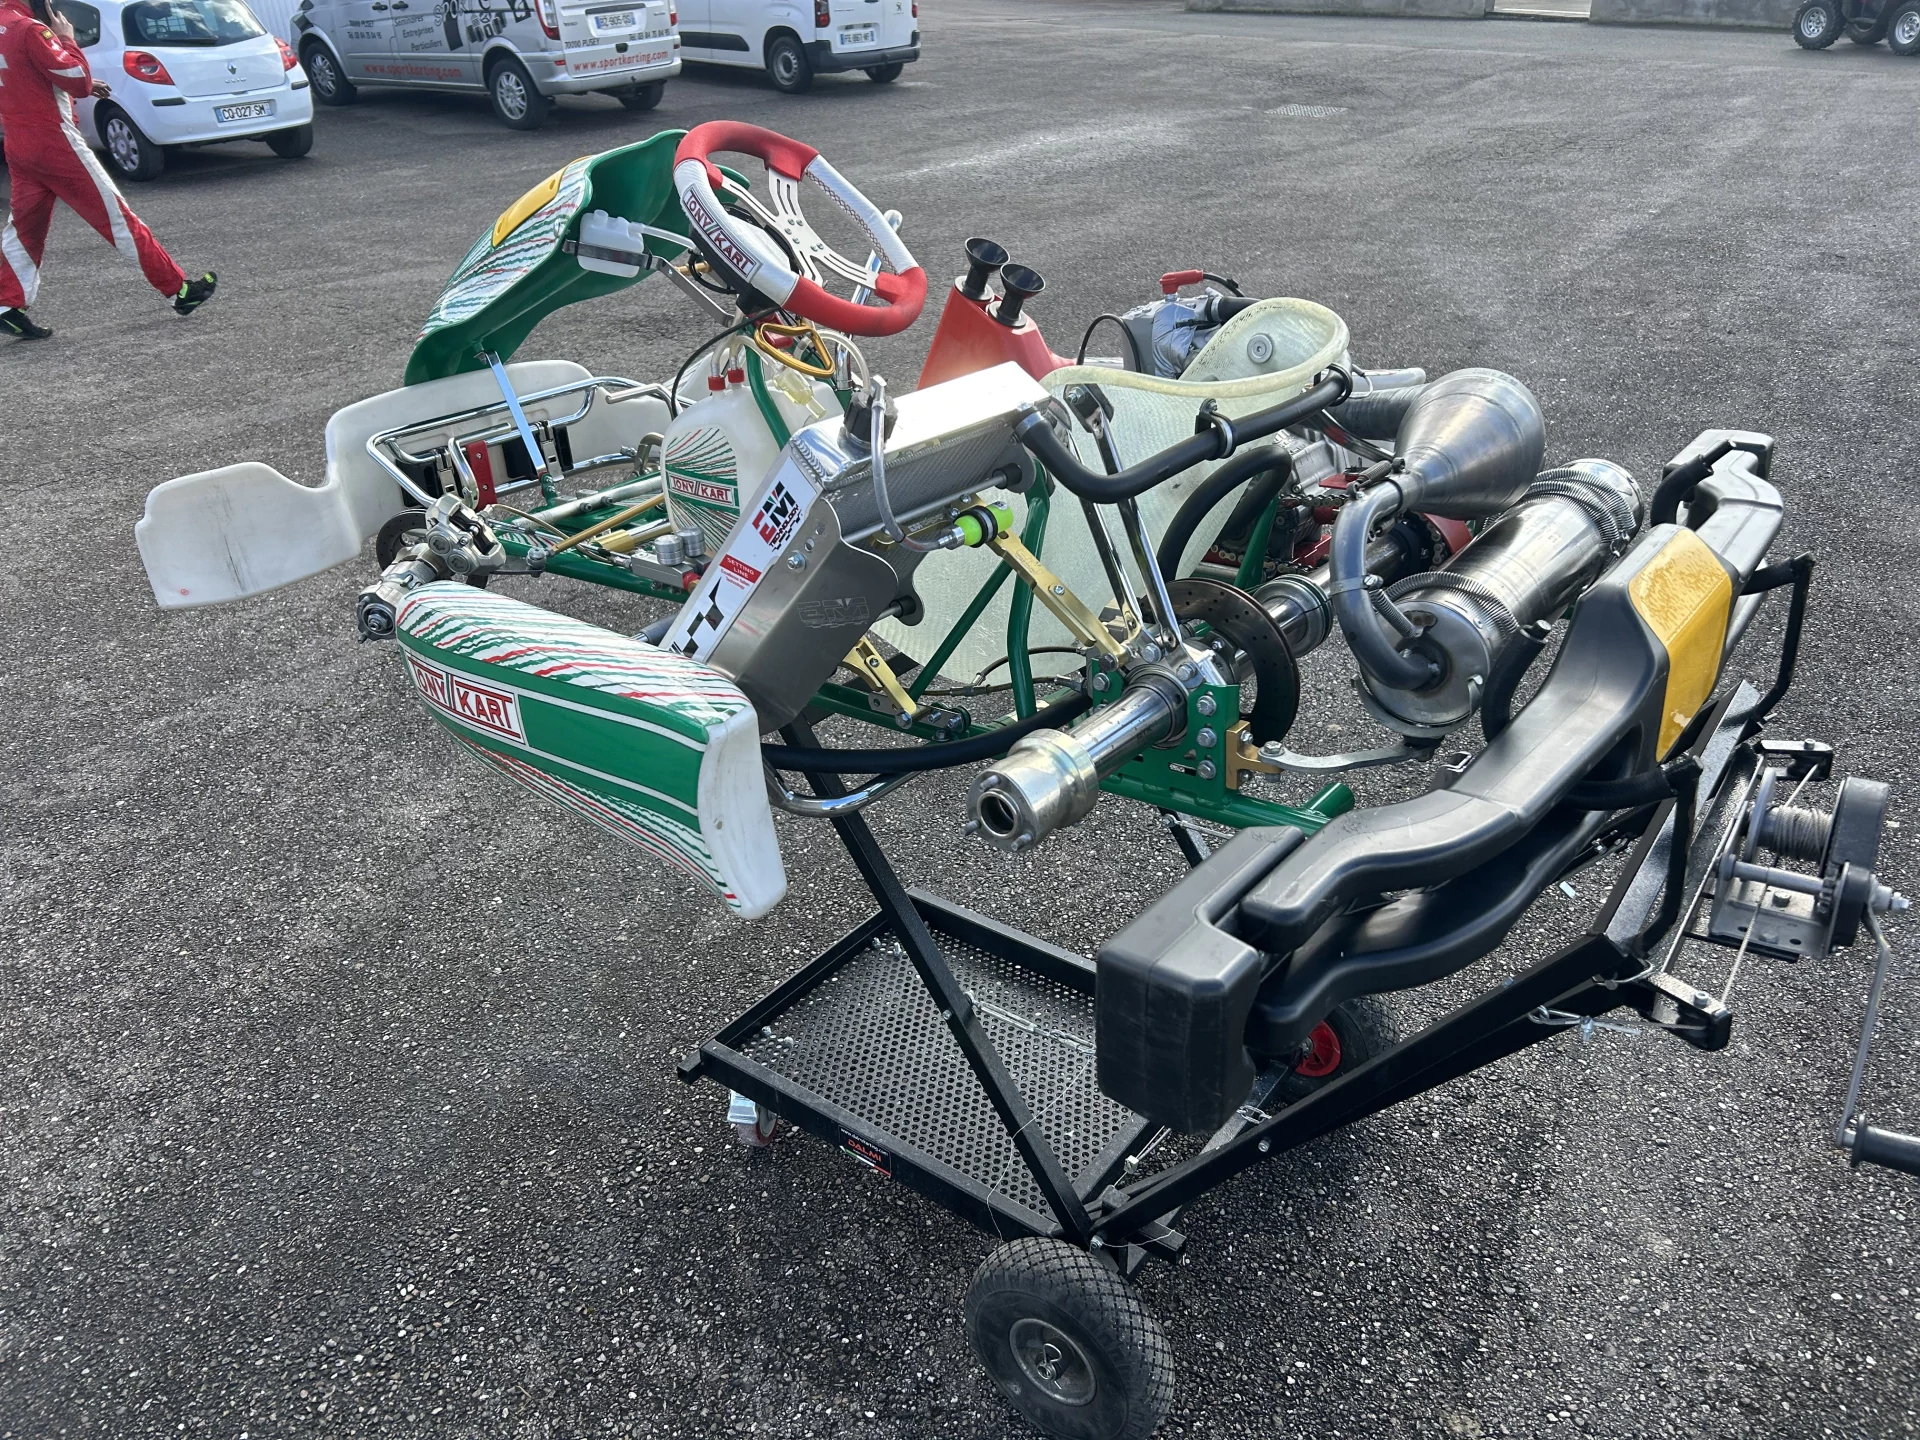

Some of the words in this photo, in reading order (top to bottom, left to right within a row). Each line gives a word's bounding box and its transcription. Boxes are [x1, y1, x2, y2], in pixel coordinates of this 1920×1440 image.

[402, 26, 434, 39] Entreprises
[411, 39, 442, 52] Particuliers
[582, 38, 600, 47] PUSEY
[574, 50, 669, 71] www.sportkarting.com
[363, 63, 463, 80] www.sportkarting.com
[713, 230, 755, 270] KART
[701, 483, 731, 501] KART
[769, 504, 799, 547] TECHNOLOGY
[726, 557, 755, 575] SETTING
[733, 566, 749, 579] LINE
[455, 680, 513, 729] KART
[847, 1139, 882, 1162] DALMI
